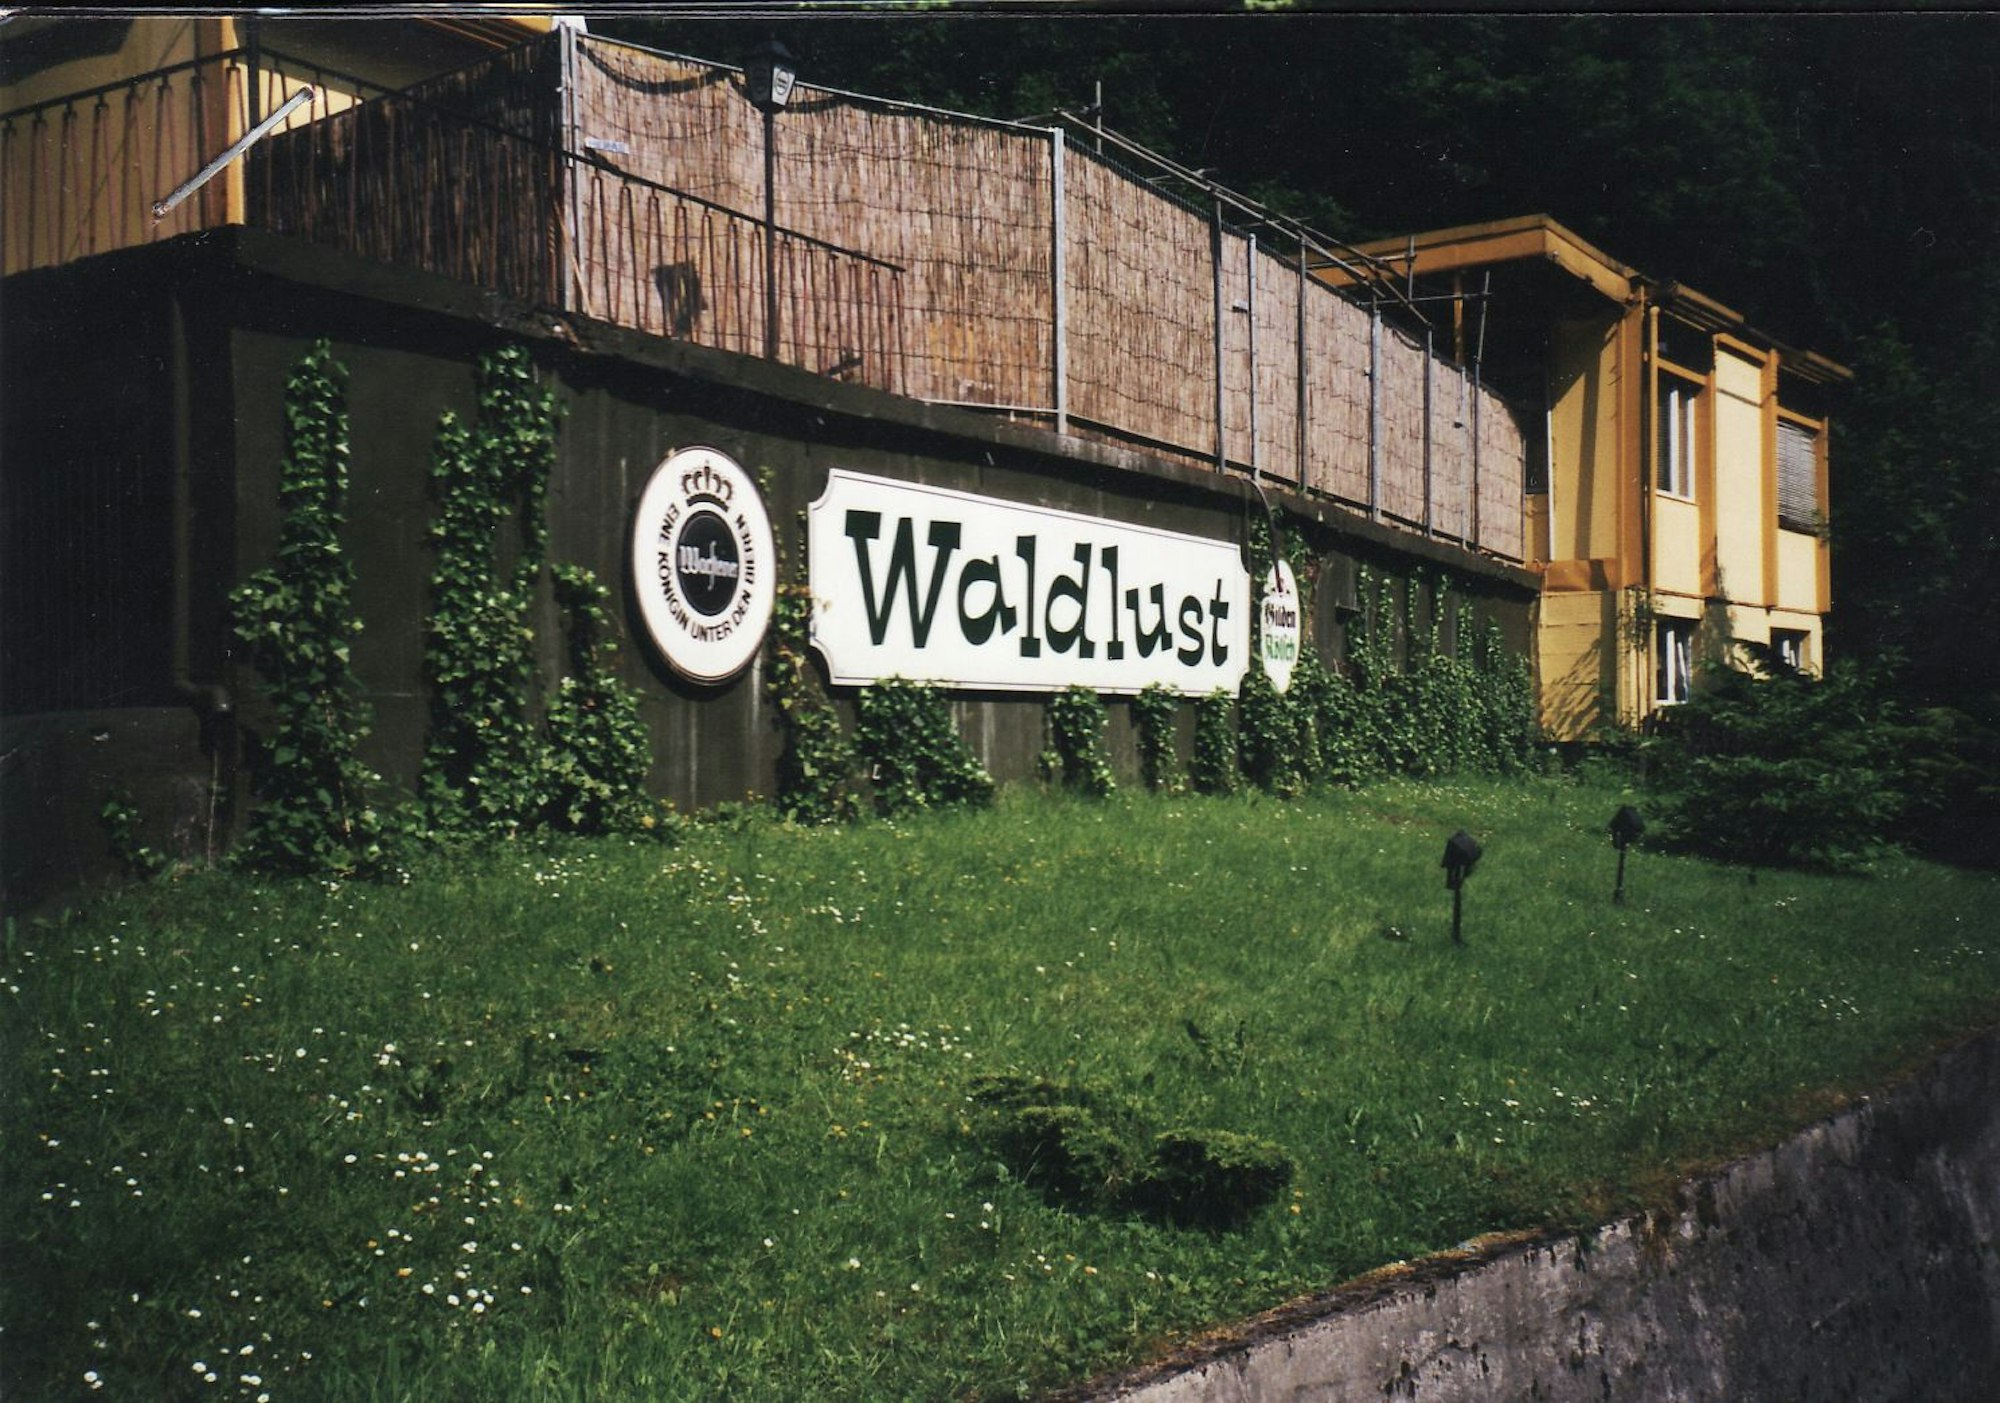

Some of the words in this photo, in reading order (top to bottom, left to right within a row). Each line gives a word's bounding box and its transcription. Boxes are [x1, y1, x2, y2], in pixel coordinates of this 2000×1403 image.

[658, 502, 680, 545] EINE
[690, 620, 733, 643] UNTER
[734, 589, 752, 627] DEN
[844, 508, 1229, 668] Waldlust
